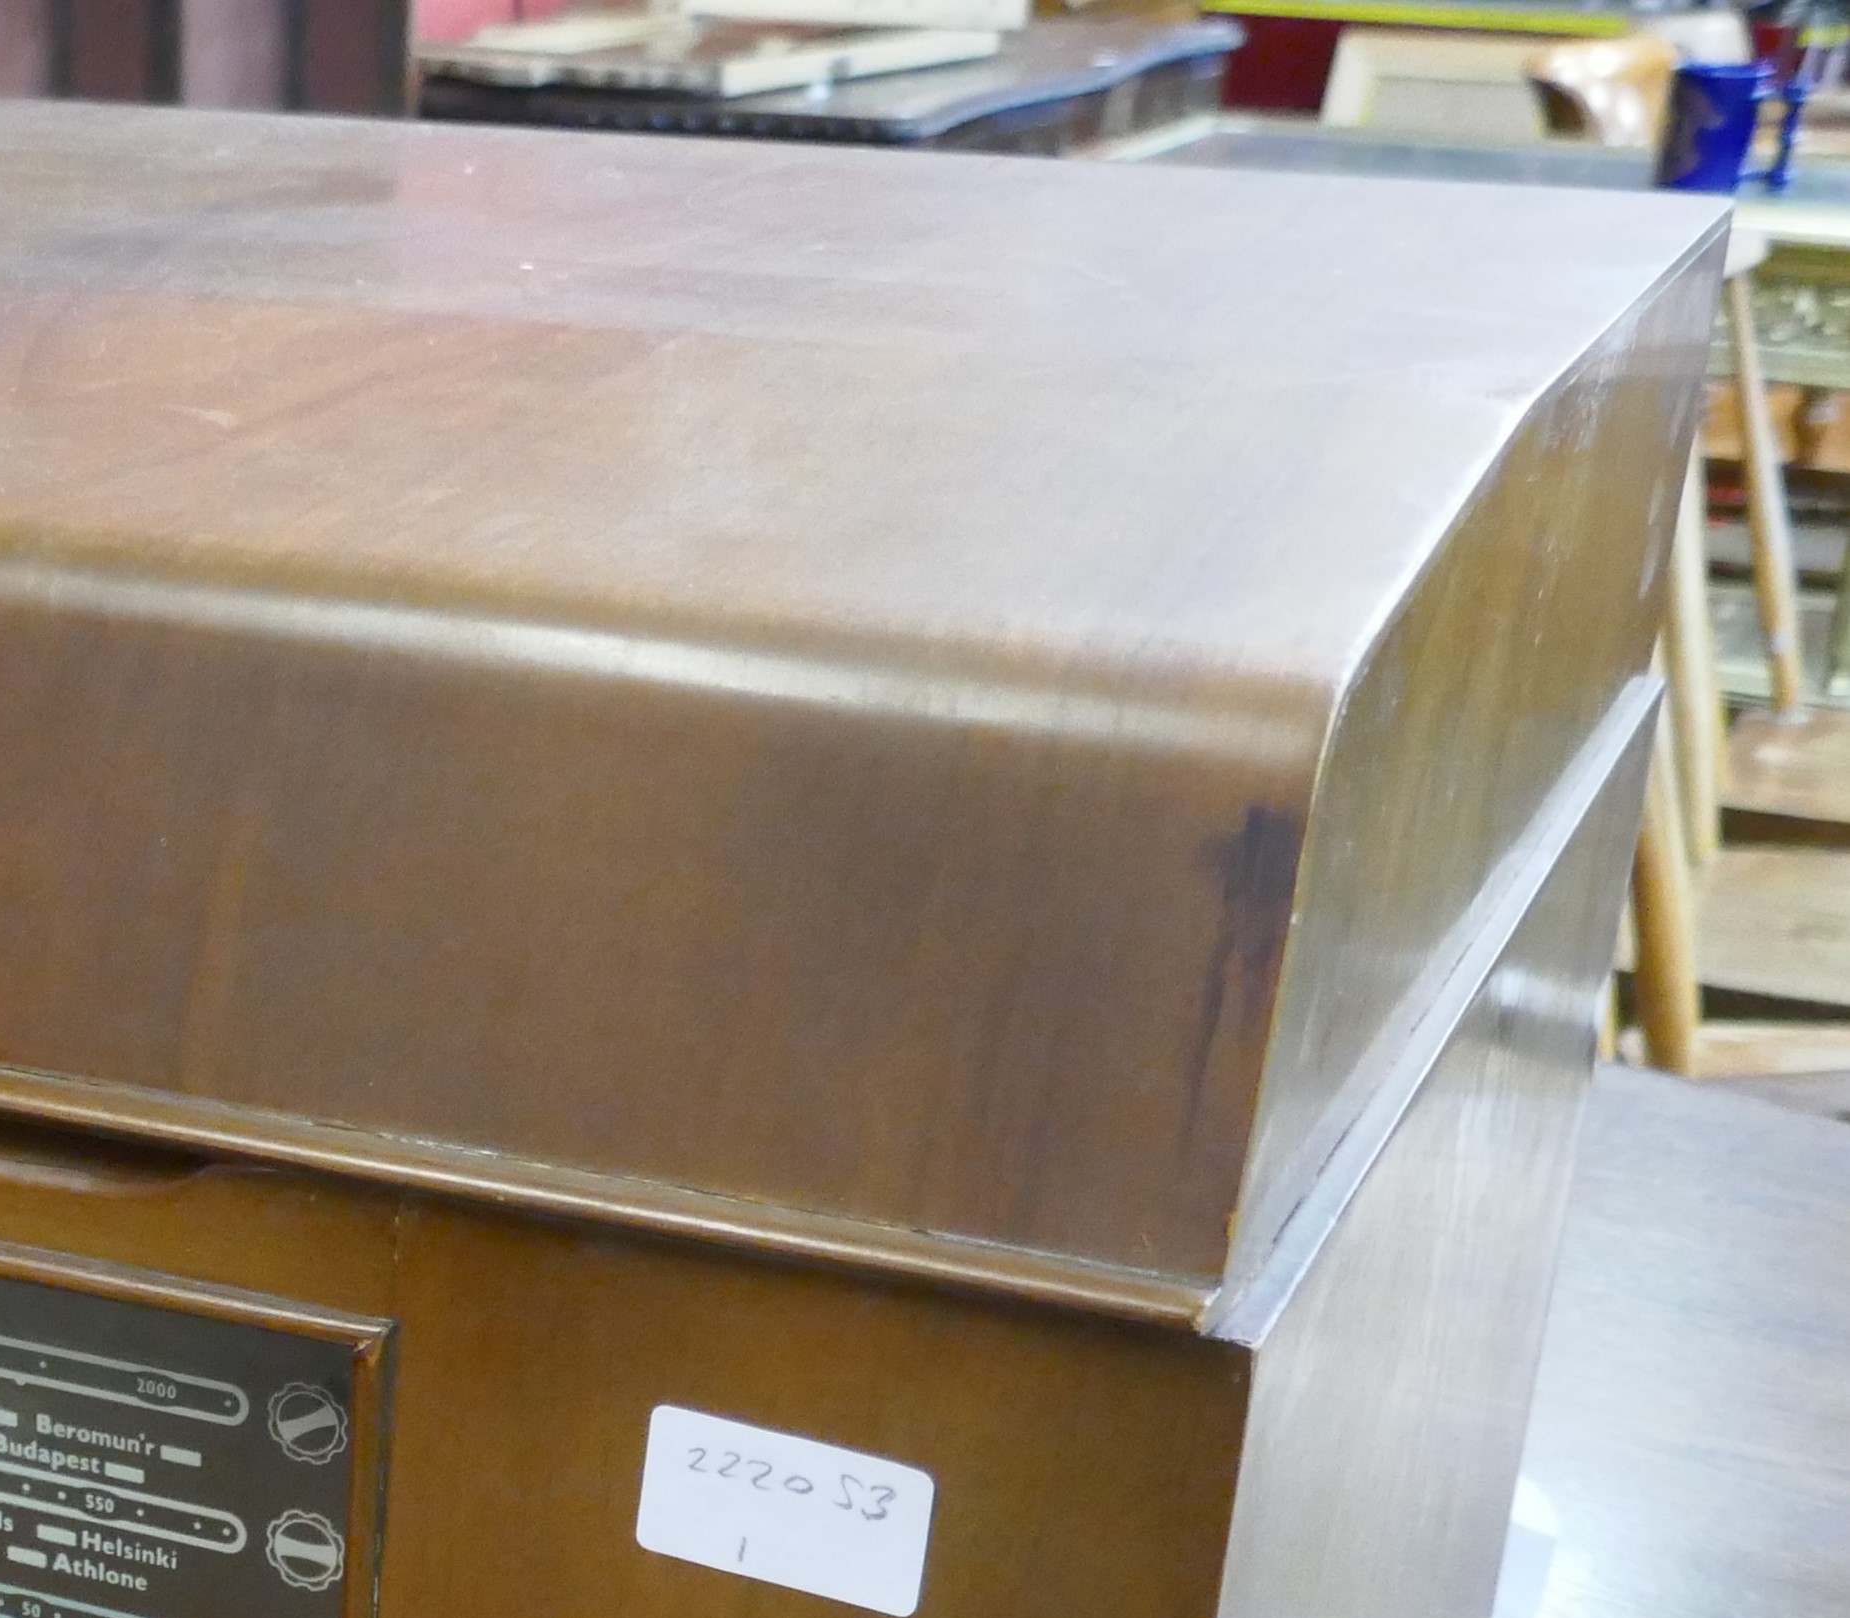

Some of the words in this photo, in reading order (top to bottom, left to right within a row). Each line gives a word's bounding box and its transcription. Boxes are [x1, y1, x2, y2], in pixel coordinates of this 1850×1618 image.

[136, 1377, 176, 1399] 2000
[36, 1413, 155, 1456] Beromun'r
[85, 1493, 114, 1513] 550
[81, 1530, 178, 1570] Helsinki
[52, 1552, 148, 1591] Athlone
[21, 1601, 41, 1618] 50
